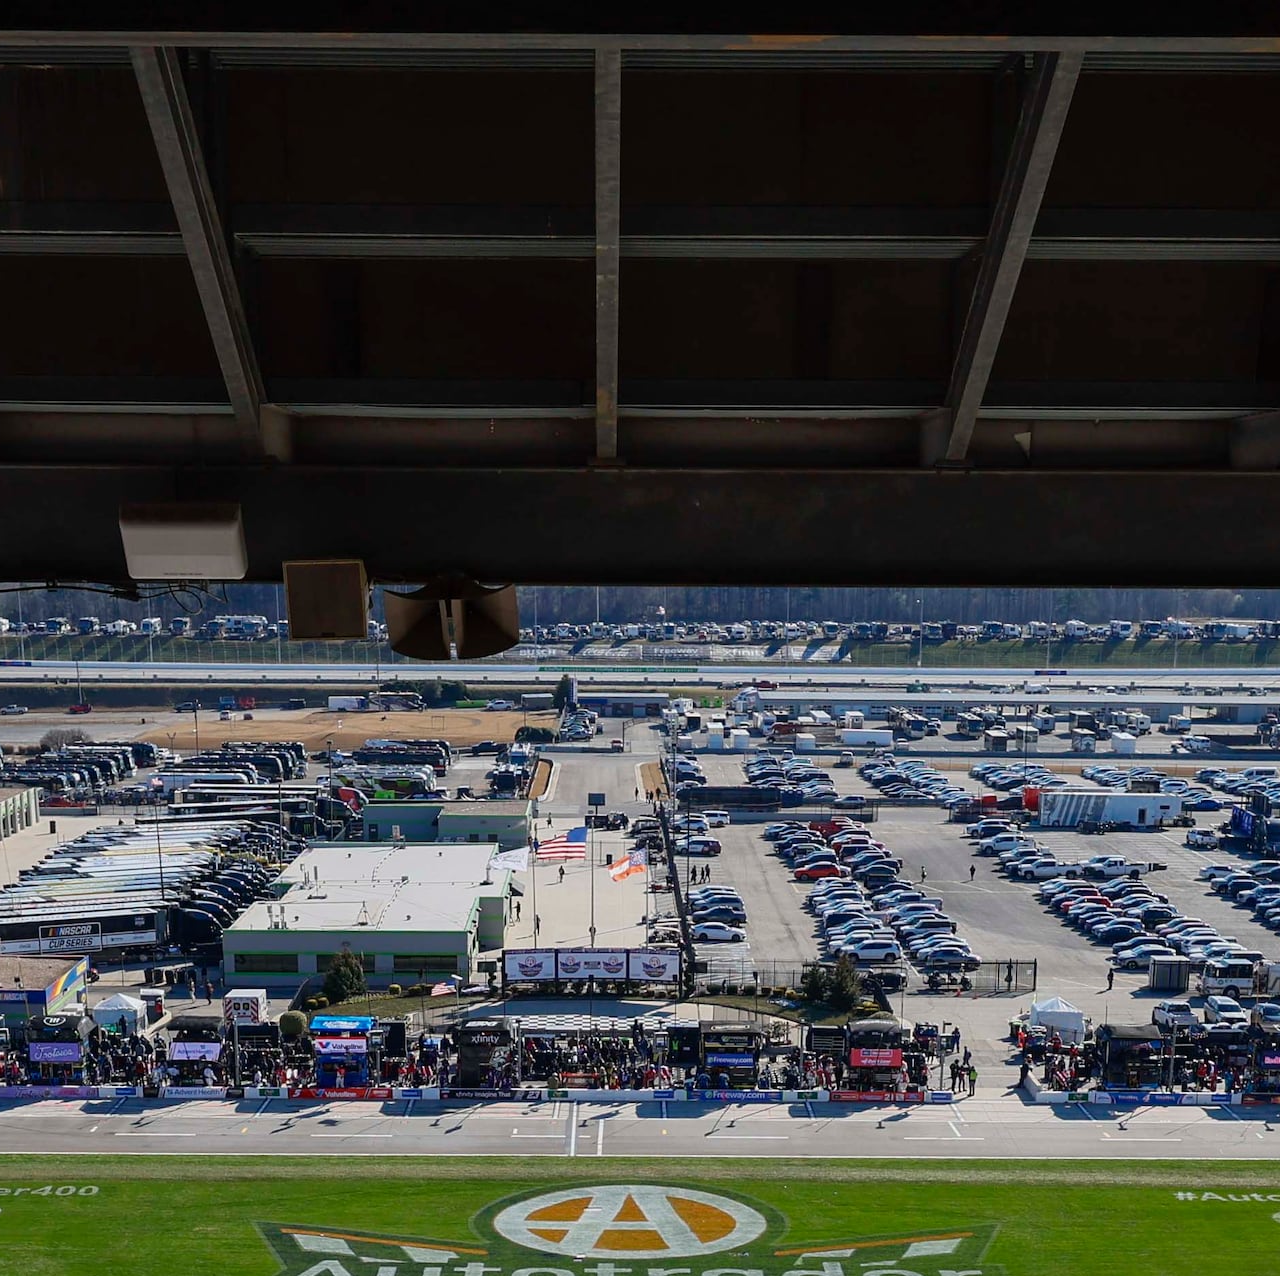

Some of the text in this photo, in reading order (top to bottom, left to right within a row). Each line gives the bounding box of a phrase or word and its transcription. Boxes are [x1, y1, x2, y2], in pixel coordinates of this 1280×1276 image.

[59, 925, 93, 936] NASCAR
[49, 937, 93, 948] CUP SERIES
[471, 1035, 499, 1044] xfinity
[713, 1055, 753, 1064] Freeway.com
